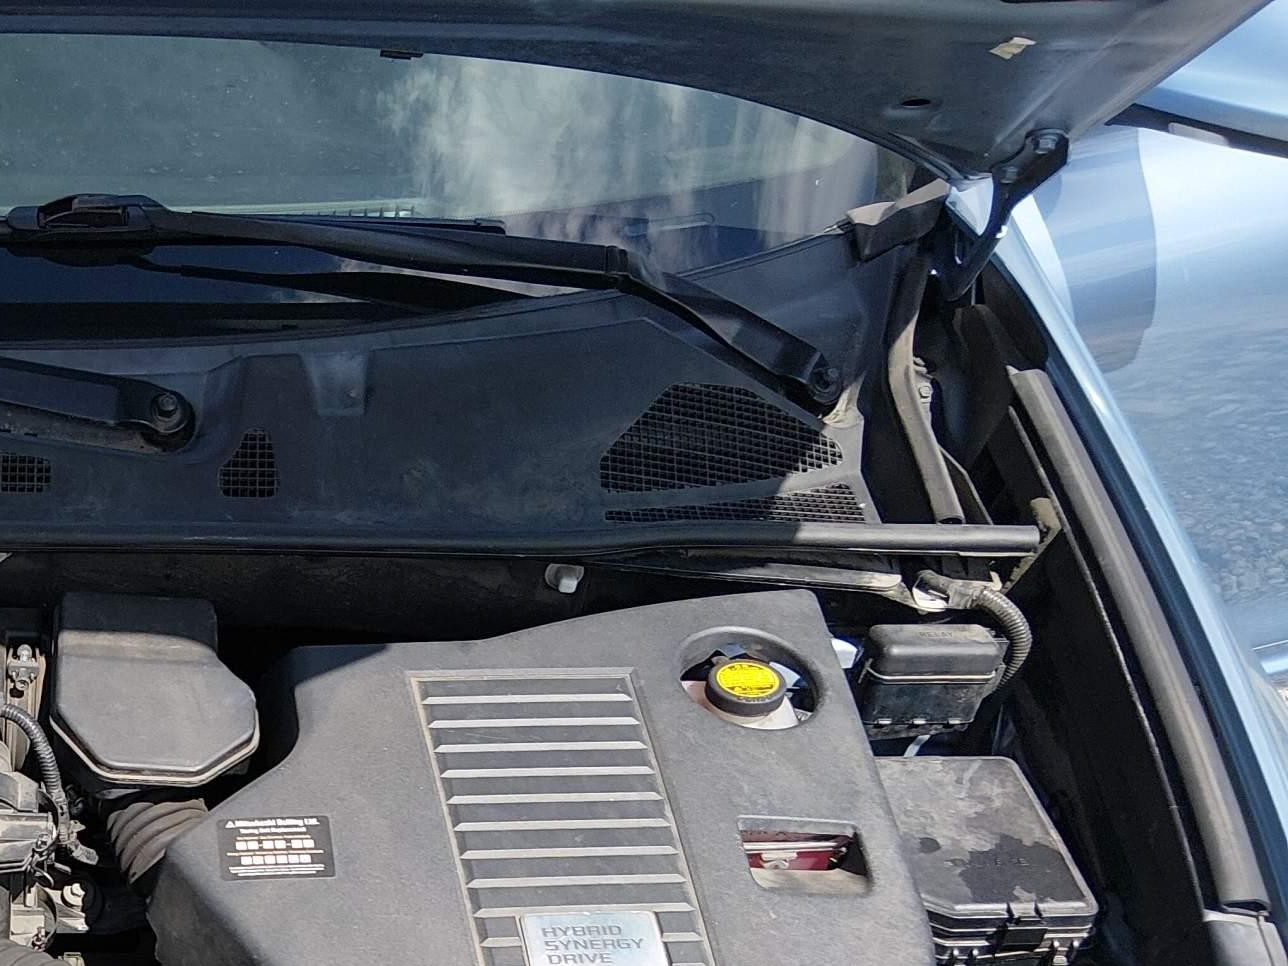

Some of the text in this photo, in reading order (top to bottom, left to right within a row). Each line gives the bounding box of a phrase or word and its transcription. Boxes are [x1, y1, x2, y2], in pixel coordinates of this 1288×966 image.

[541, 925, 622, 937] HYBRID
[544, 938, 643, 951] SYNERGY
[547, 952, 614, 965] DRIVE
